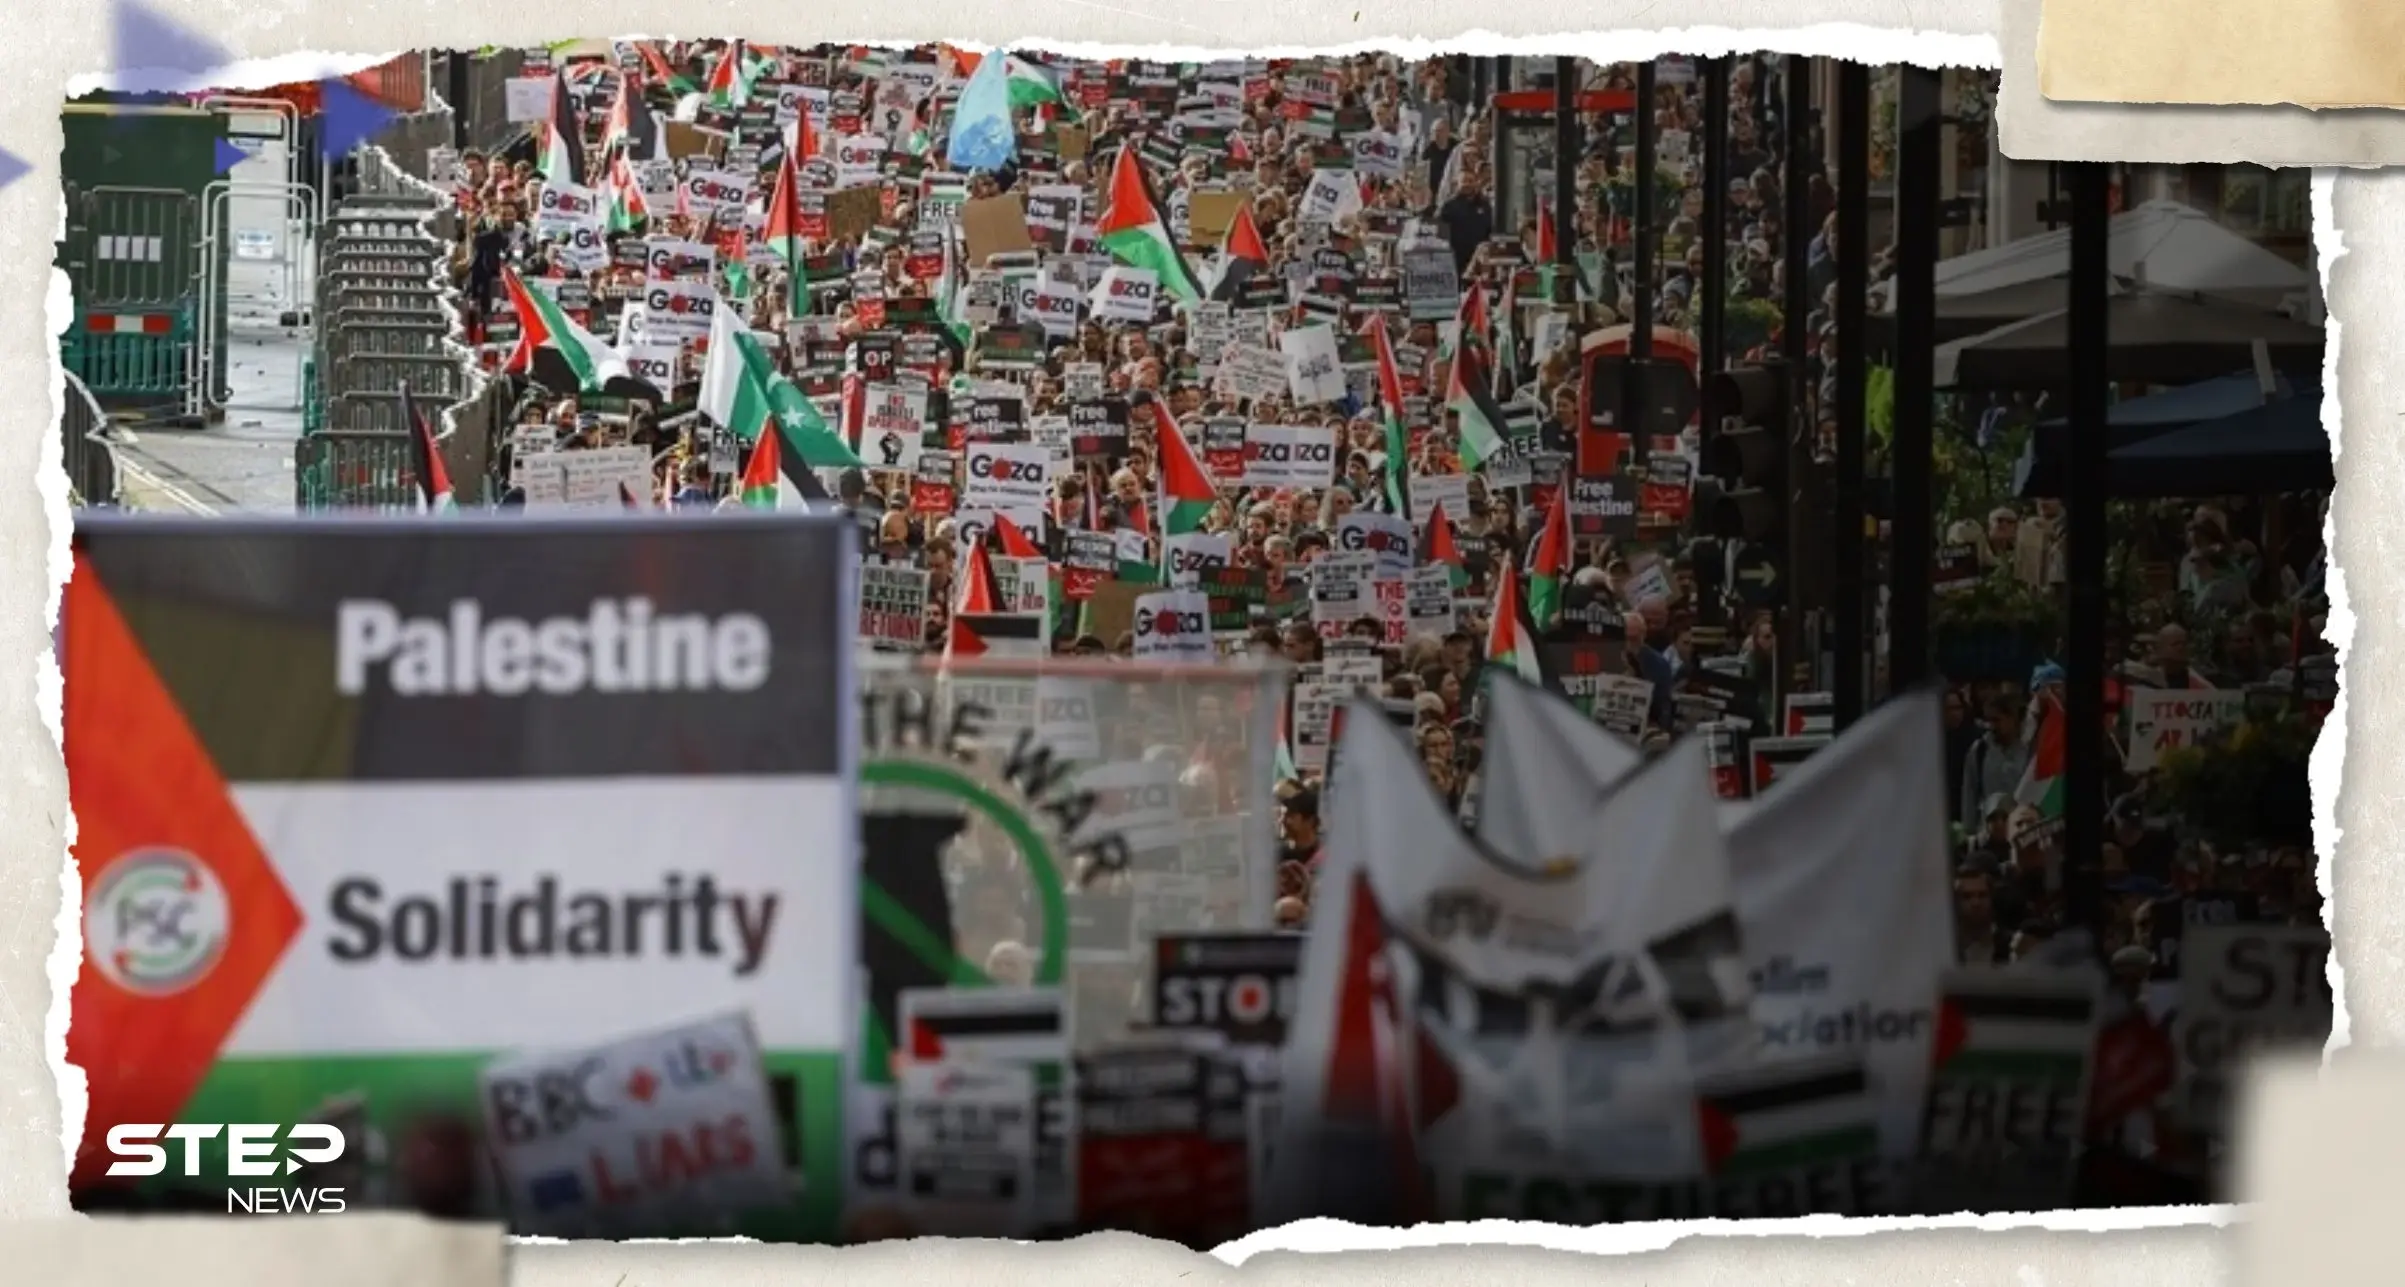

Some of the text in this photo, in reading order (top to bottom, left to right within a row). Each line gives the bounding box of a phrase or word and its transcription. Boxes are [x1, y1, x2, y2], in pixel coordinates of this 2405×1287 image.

[1110, 278, 1150, 298] za
[629, 359, 669, 378] za
[864, 351, 892, 367] OP
[1296, 443, 1331, 462] za
[1574, 477, 1614, 497] Free
[335, 596, 772, 695] Palestine
[1003, 725, 1132, 888] WAR
[326, 874, 780, 977] Solidarity
[491, 1056, 617, 1146] BBC
